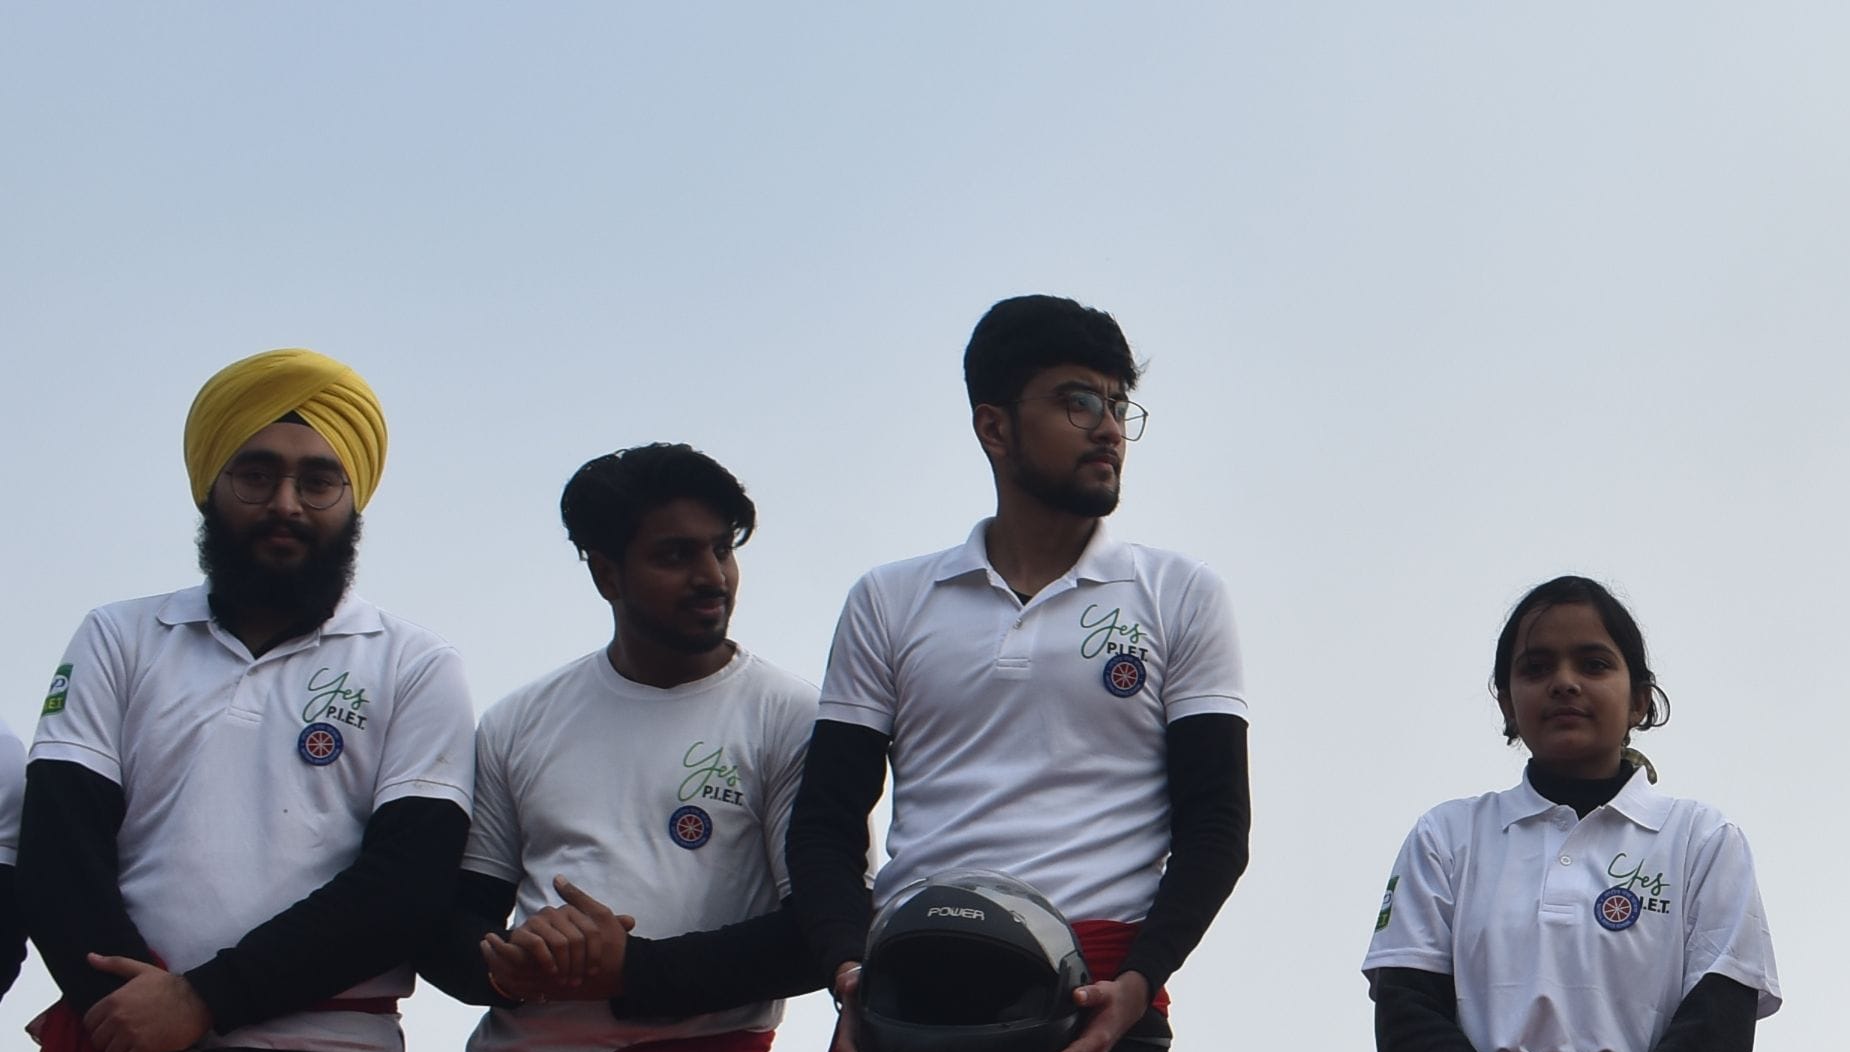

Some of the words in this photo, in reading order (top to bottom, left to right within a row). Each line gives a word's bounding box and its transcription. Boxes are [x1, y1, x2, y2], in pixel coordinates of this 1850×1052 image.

[1080, 603, 1148, 659] Yes
[302, 667, 370, 723] Yes
[678, 741, 742, 802] Yes
[927, 906, 985, 921] POWER
